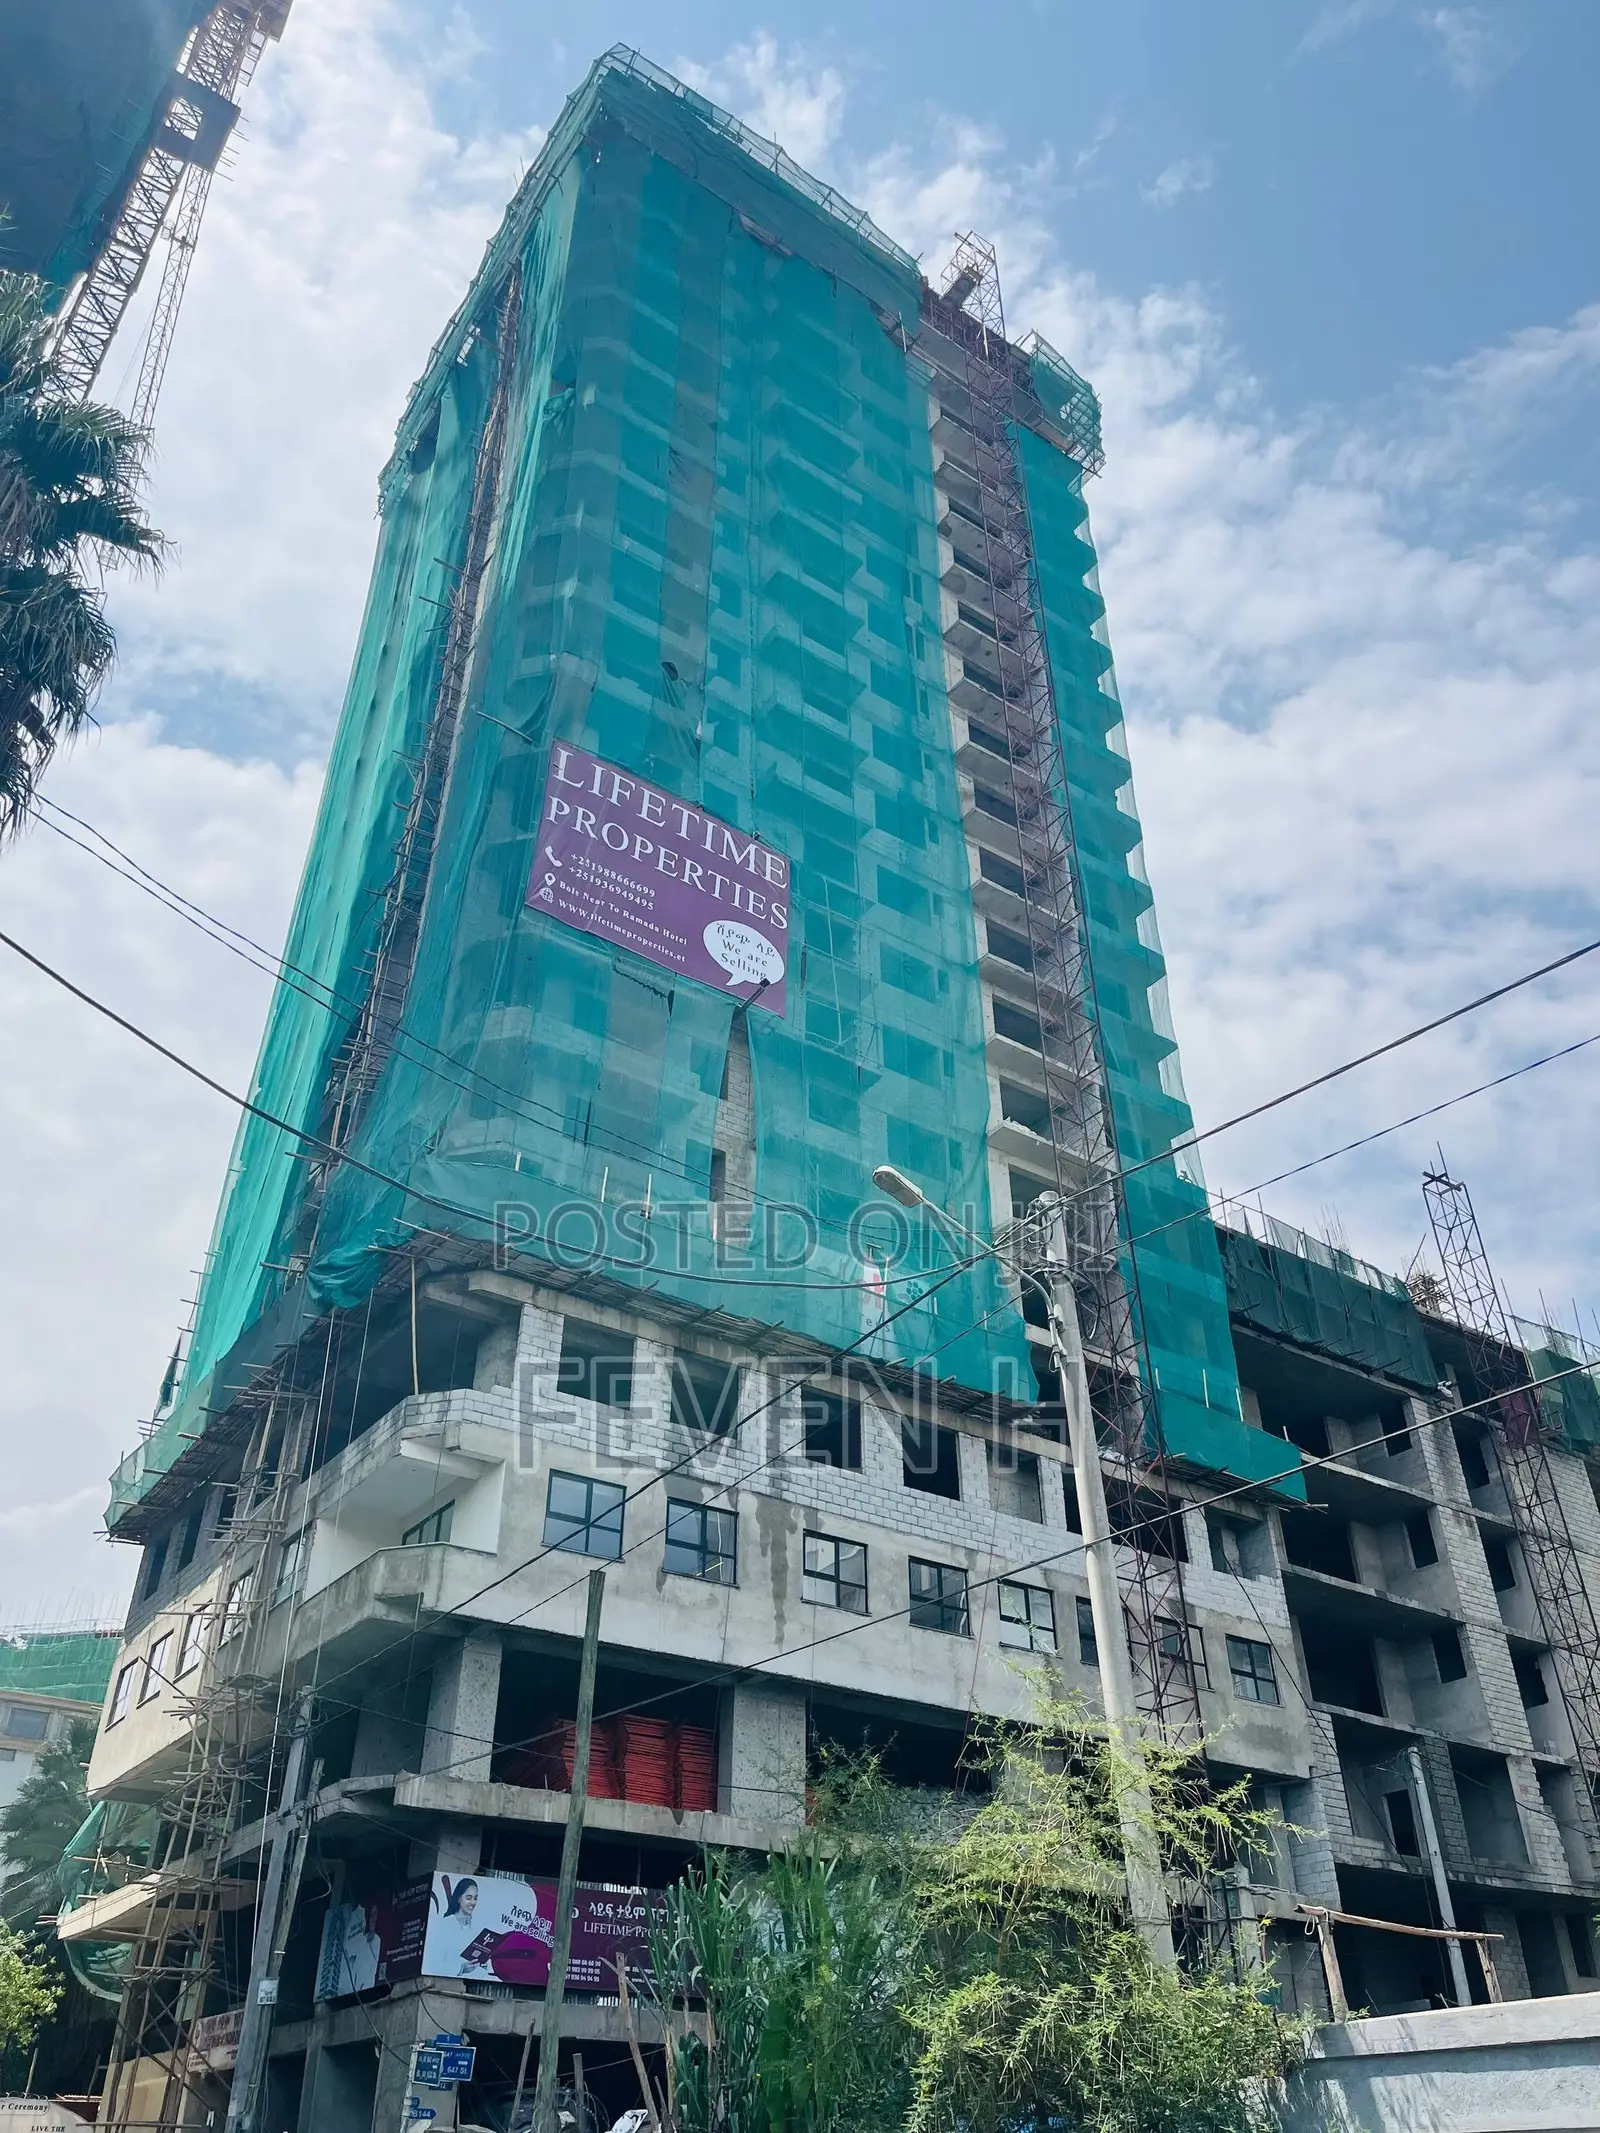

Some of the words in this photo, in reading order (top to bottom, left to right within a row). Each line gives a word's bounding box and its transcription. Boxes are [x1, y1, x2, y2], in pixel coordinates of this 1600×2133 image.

[553, 747, 788, 889] LIFETIME
[545, 795, 788, 930] PROPERTIES
[571, 853, 656, 898] +251988666699
[568, 865, 655, 911] +251936949495
[582, 892, 606, 907] Near
[608, 902, 620, 914] To
[622, 909, 660, 933] Ramada
[663, 928, 687, 946] Hotel
[720, 952, 767, 981] Selling
[721, 938, 741, 955] We
[747, 953, 768, 967] are
[501, 1914, 514, 1927] We
[514, 1921, 528, 1933] are
[528, 1928, 555, 1947] selling
[584, 1921, 632, 1937] LIFETIME
[8, 2103, 48, 2112] Ceremony
